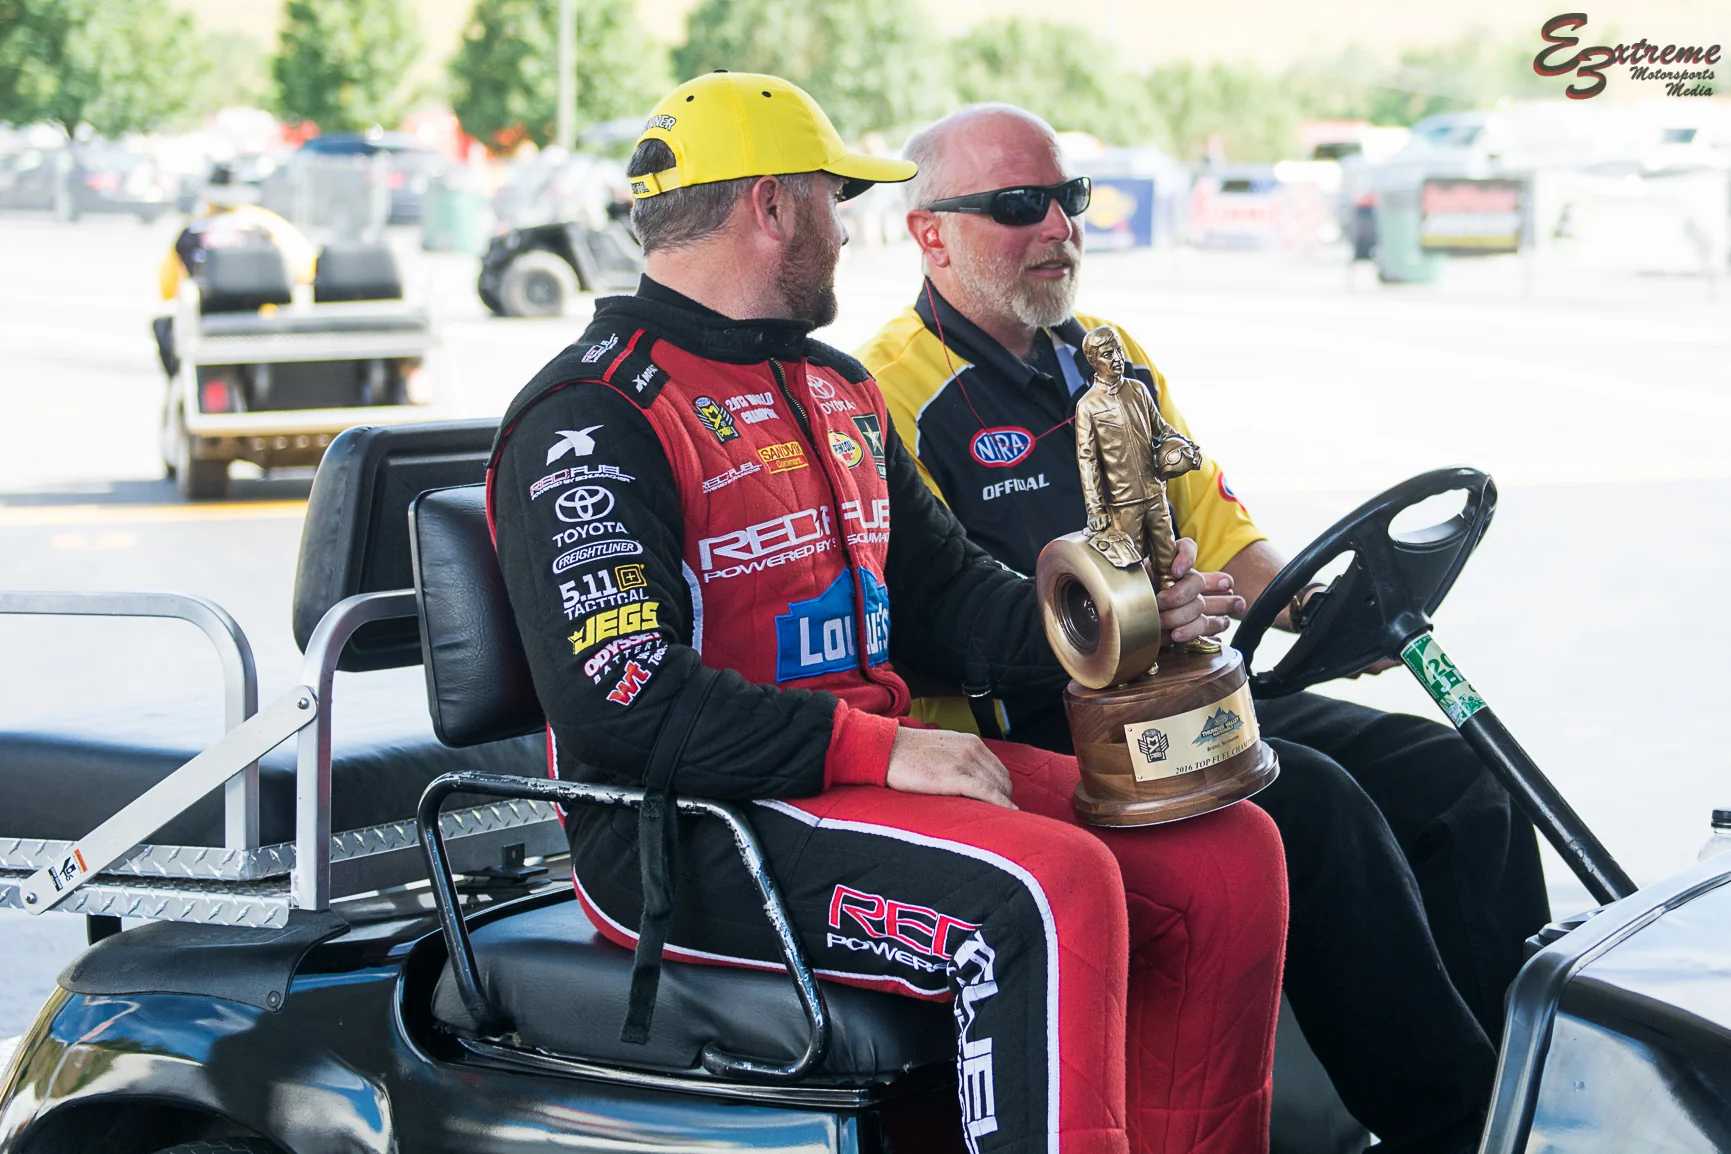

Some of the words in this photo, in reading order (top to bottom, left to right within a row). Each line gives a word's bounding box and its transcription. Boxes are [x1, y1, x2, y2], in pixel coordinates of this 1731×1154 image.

[552, 521, 630, 548] TOYOTA
[558, 542, 635, 570] FREIGHTLINER
[703, 544, 815, 583] POWERED
[815, 540, 832, 554] BY
[559, 569, 618, 609] 5.11
[564, 588, 650, 621] TACTICAL
[568, 602, 661, 655] JEGS
[594, 639, 662, 685] BATTERY
[1175, 765, 1193, 774] 2016
[1195, 758, 1211, 769] TOP
[1212, 751, 1230, 763] FUEL
